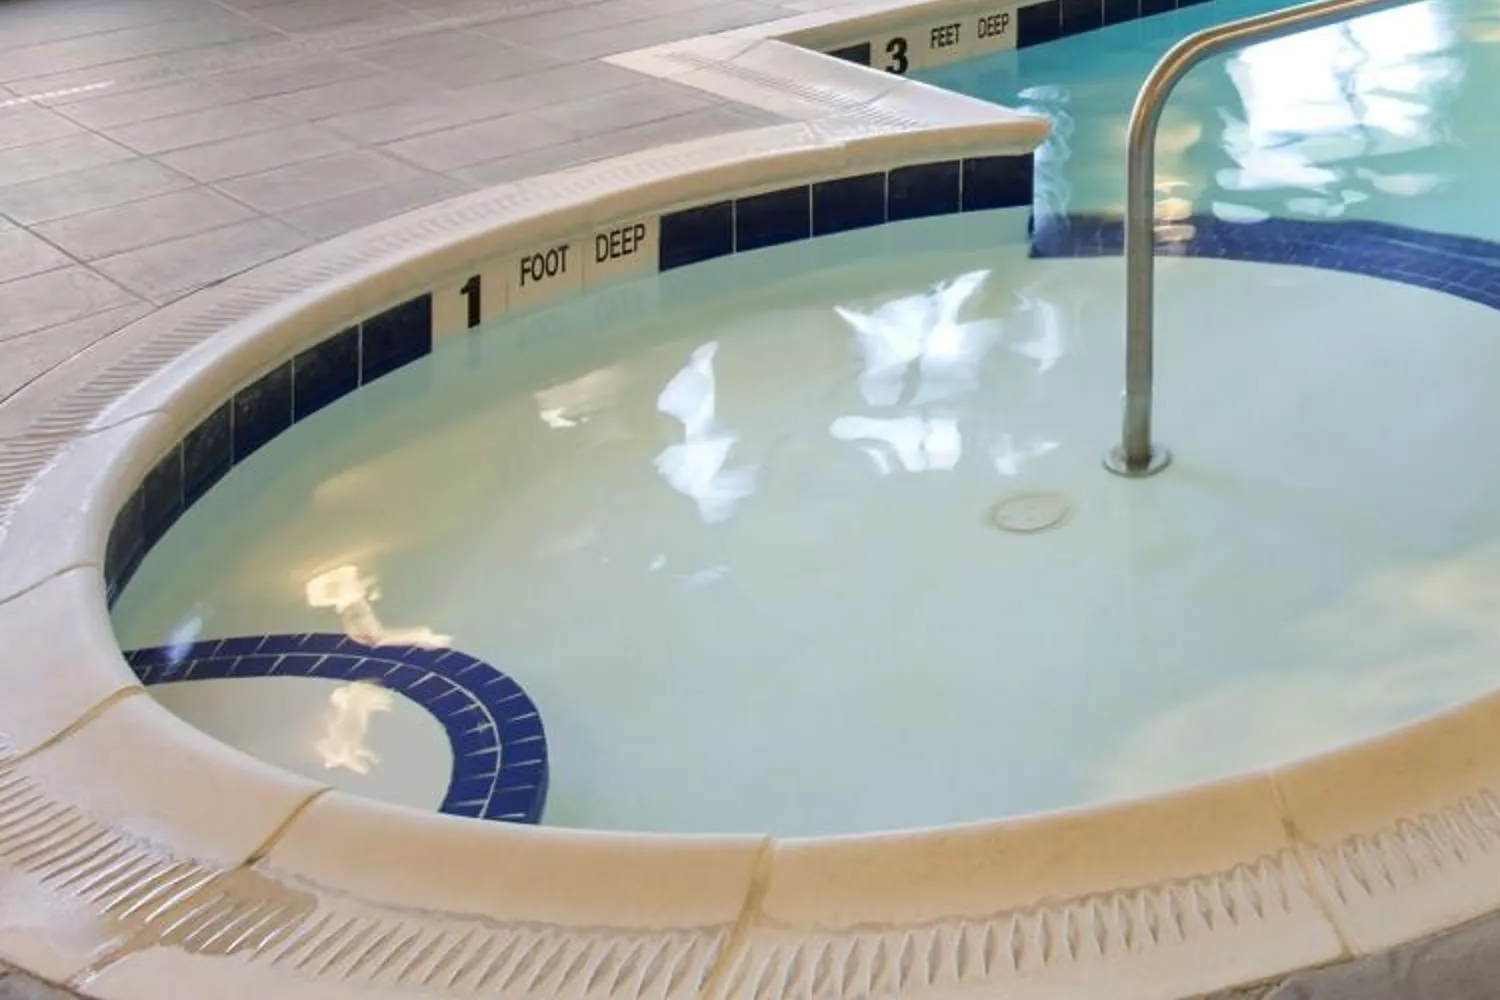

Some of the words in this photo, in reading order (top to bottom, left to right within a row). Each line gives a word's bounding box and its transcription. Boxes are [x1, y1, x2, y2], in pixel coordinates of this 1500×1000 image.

[886, 37, 908, 74] 3
[930, 23, 961, 49] FEET
[977, 13, 1009, 39] DEEP
[459, 274, 481, 329] 1
[520, 244, 569, 287] FOOT
[595, 223, 646, 264] DEEP
